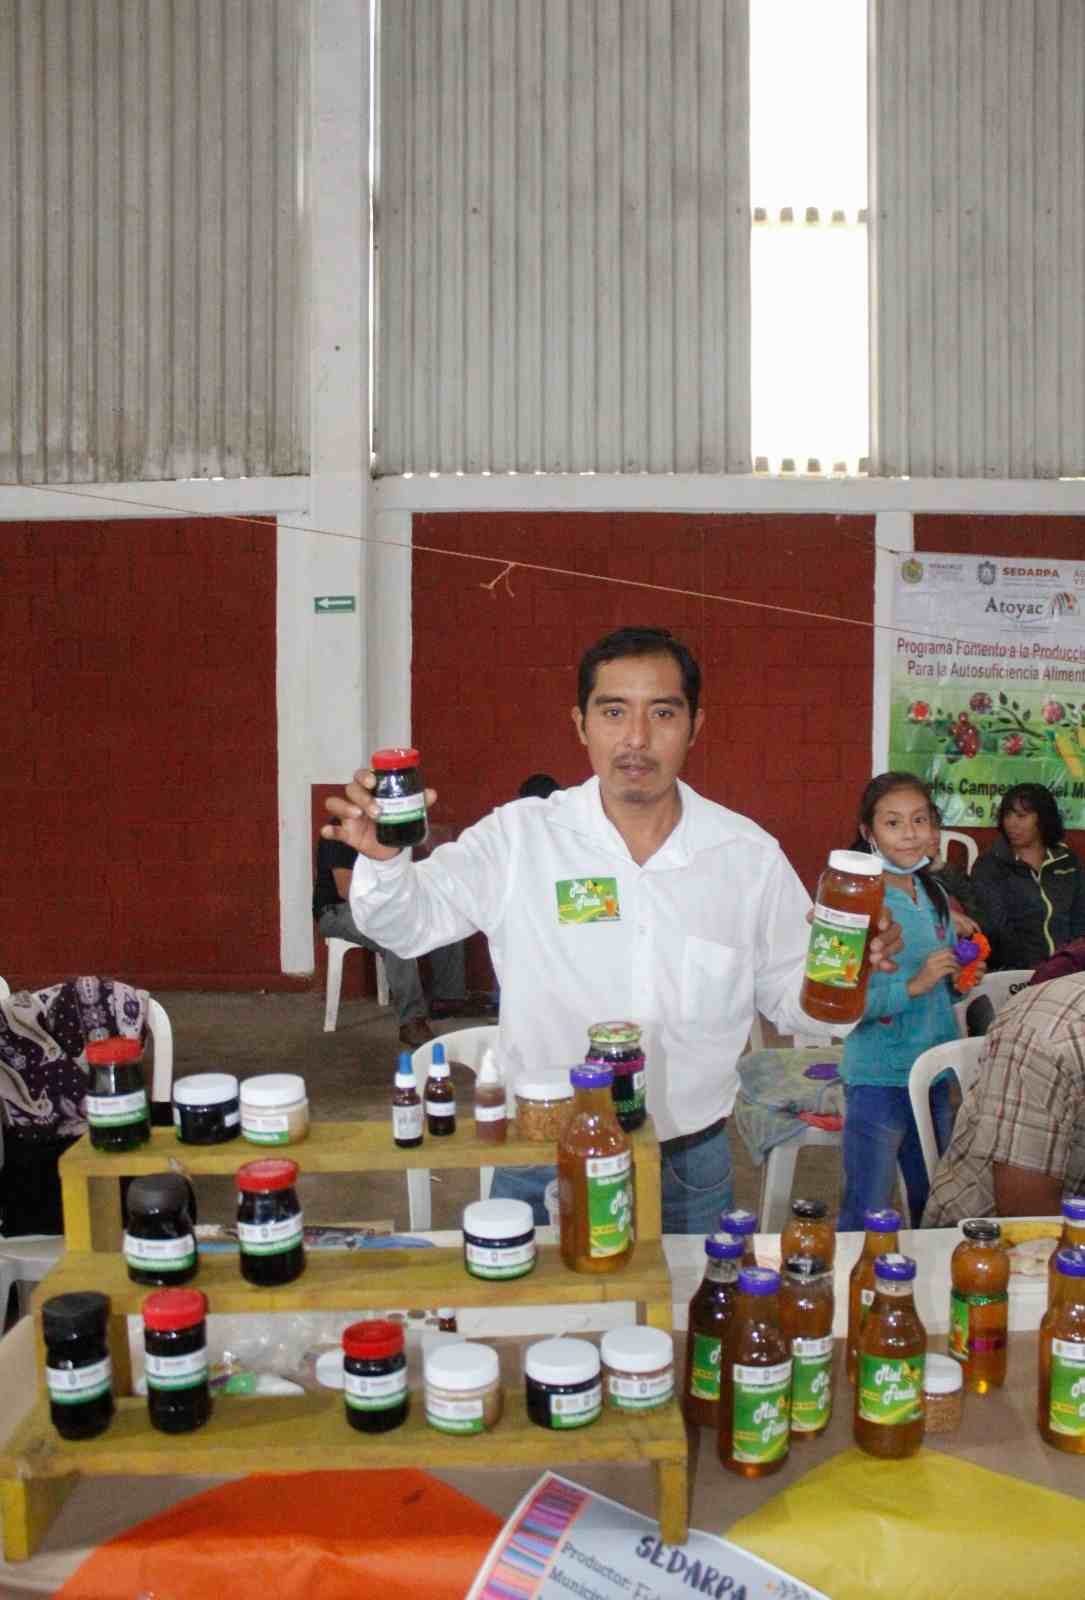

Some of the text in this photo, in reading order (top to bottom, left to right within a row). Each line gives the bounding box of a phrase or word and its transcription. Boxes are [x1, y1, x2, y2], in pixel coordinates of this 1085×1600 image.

[1001, 567, 1060, 578] SEDARPA
[984, 596, 1044, 618] Atoyac
[896, 637, 953, 658] Programa
[956, 640, 1007, 657] Fomento
[907, 660, 934, 676] Para
[950, 663, 1040, 680] Autosuficiencia
[634, 1535, 747, 1600] SEDARPA
